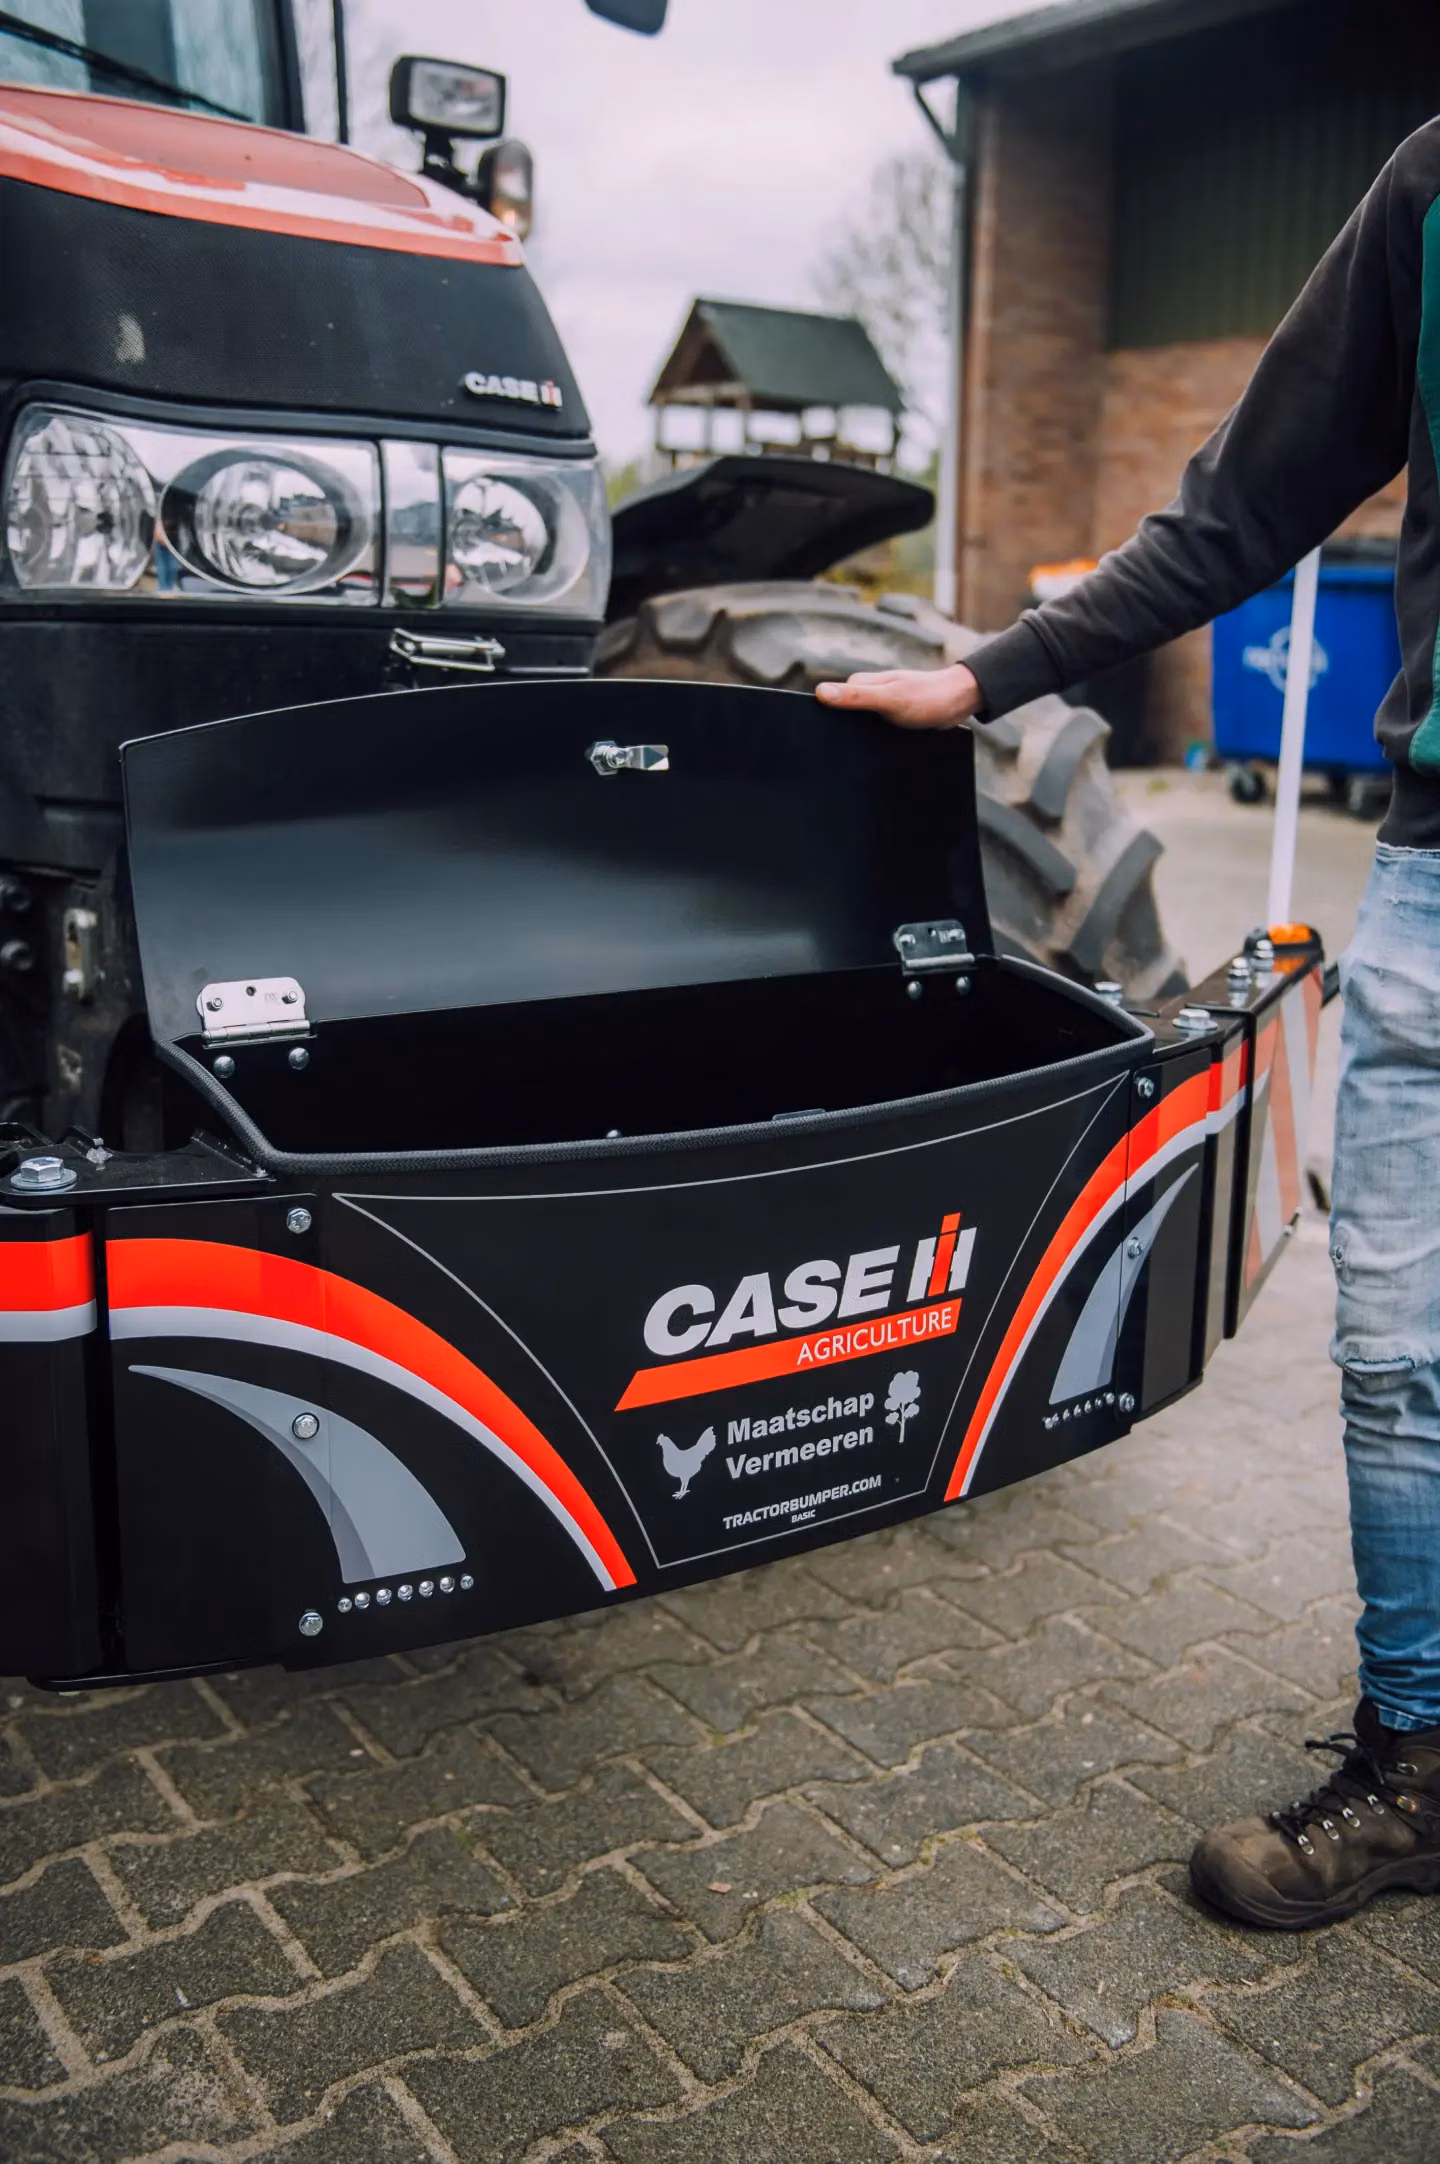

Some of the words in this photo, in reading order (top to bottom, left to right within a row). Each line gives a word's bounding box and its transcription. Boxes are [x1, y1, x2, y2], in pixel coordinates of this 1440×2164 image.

[465, 371, 539, 402] CASE
[643, 1245, 900, 1356] CASE
[797, 1308, 952, 1365] AGRICULTURE
[727, 1392, 874, 1445] Maatschap
[726, 1426, 873, 1479] Vermeeren
[723, 1474, 882, 1530] TRACTORBUMPER.COM
[791, 1509, 816, 1523] BASIC
